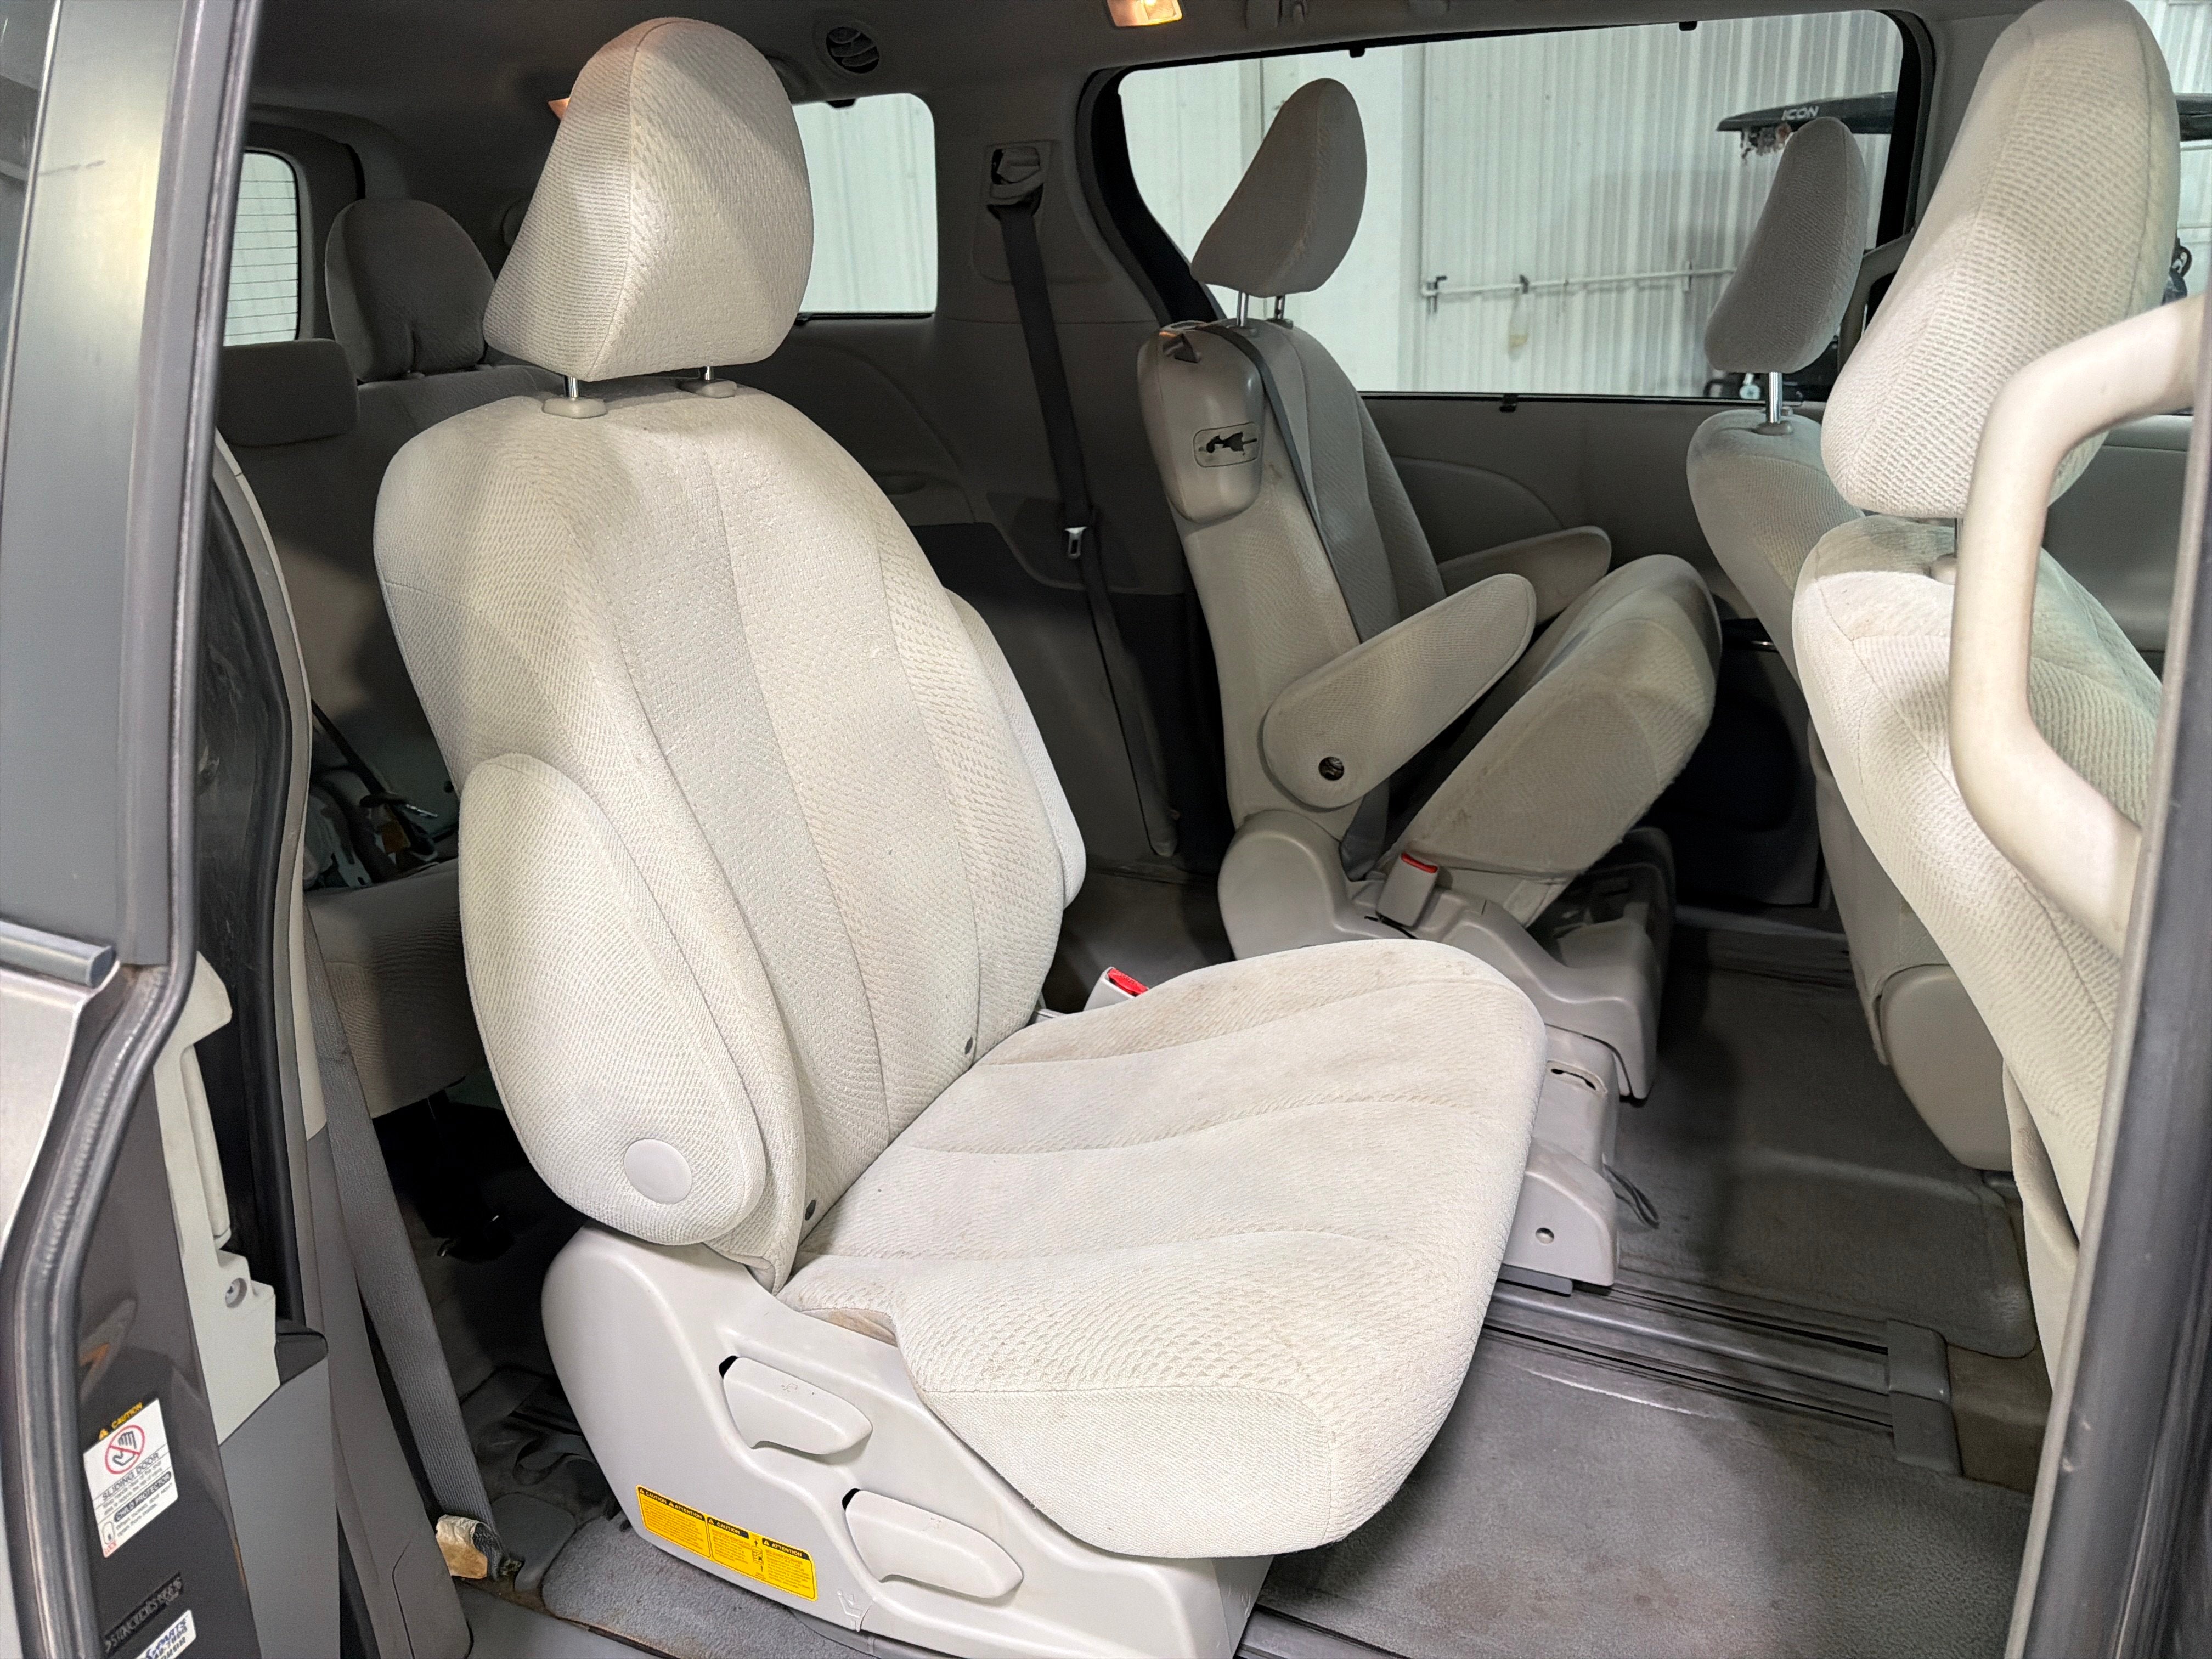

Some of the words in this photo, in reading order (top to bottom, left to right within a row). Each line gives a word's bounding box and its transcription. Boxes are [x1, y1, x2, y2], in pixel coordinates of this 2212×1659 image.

[1781, 105, 1819, 121] ICON
[111, 1402, 143, 1429] CAUTION
[103, 1471, 134, 1500] SLIDING
[136, 1453, 159, 1474] DOOR
[116, 1500, 135, 1521] CHILD
[134, 1473, 170, 1504] PROTECTOR
[645, 1491, 667, 1505] CAUTION
[674, 1504, 702, 1519] ATTENTION
[716, 1521, 741, 1535] CAUTION
[771, 1542, 803, 1557] ATTENTION
